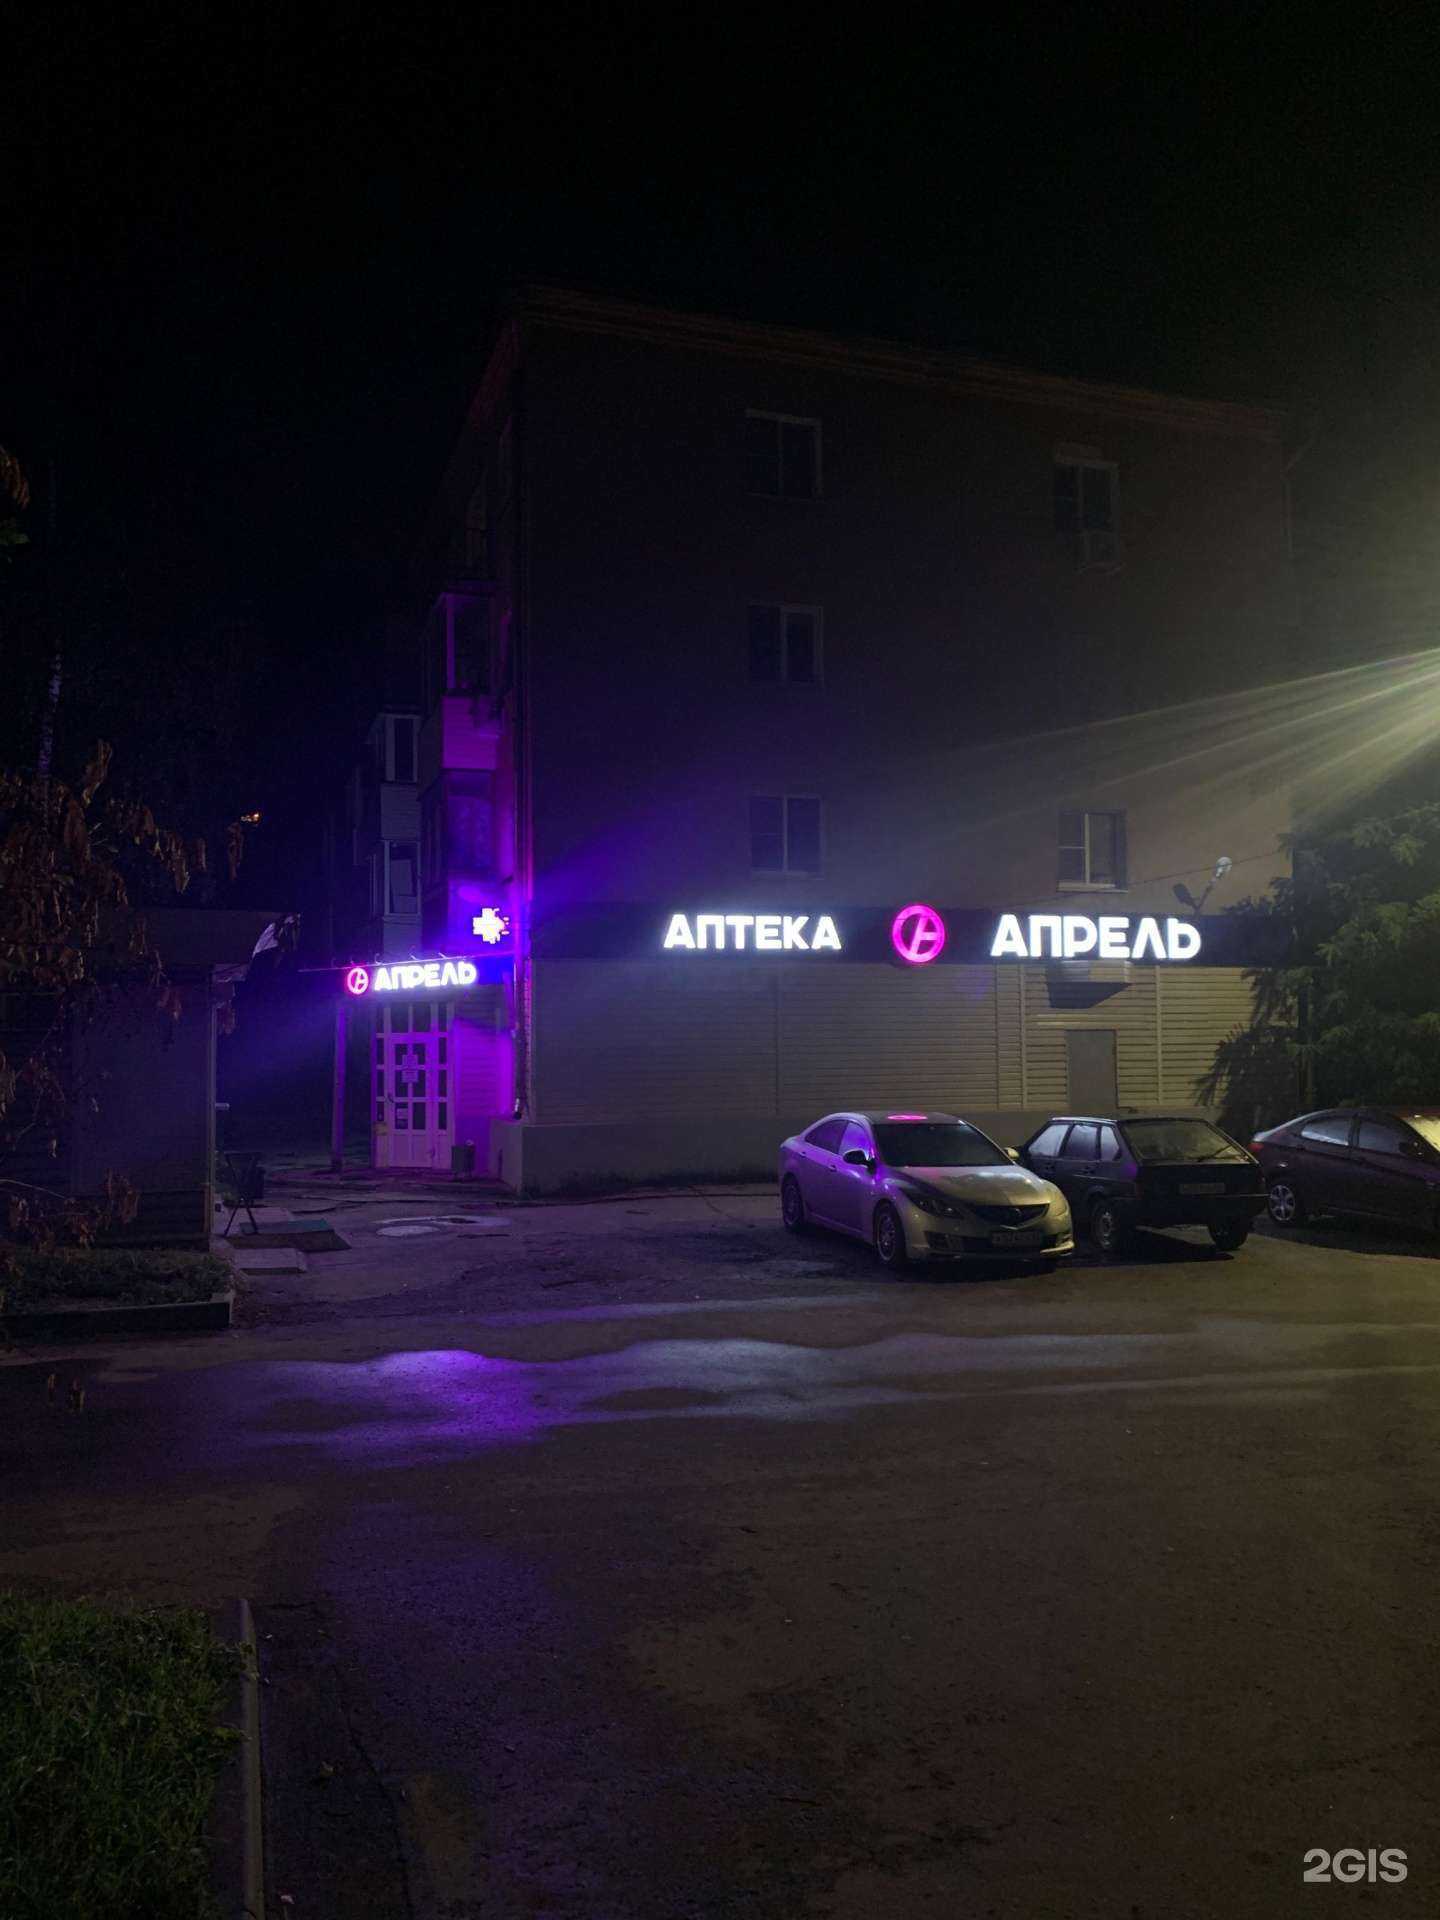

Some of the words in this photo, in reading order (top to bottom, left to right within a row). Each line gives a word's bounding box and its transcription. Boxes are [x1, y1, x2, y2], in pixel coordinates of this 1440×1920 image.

[663, 913, 842, 950] АПТЕКА
[990, 914, 1202, 960] АПРЕЛЬ
[374, 961, 477, 991] АПРЕЛЬ
